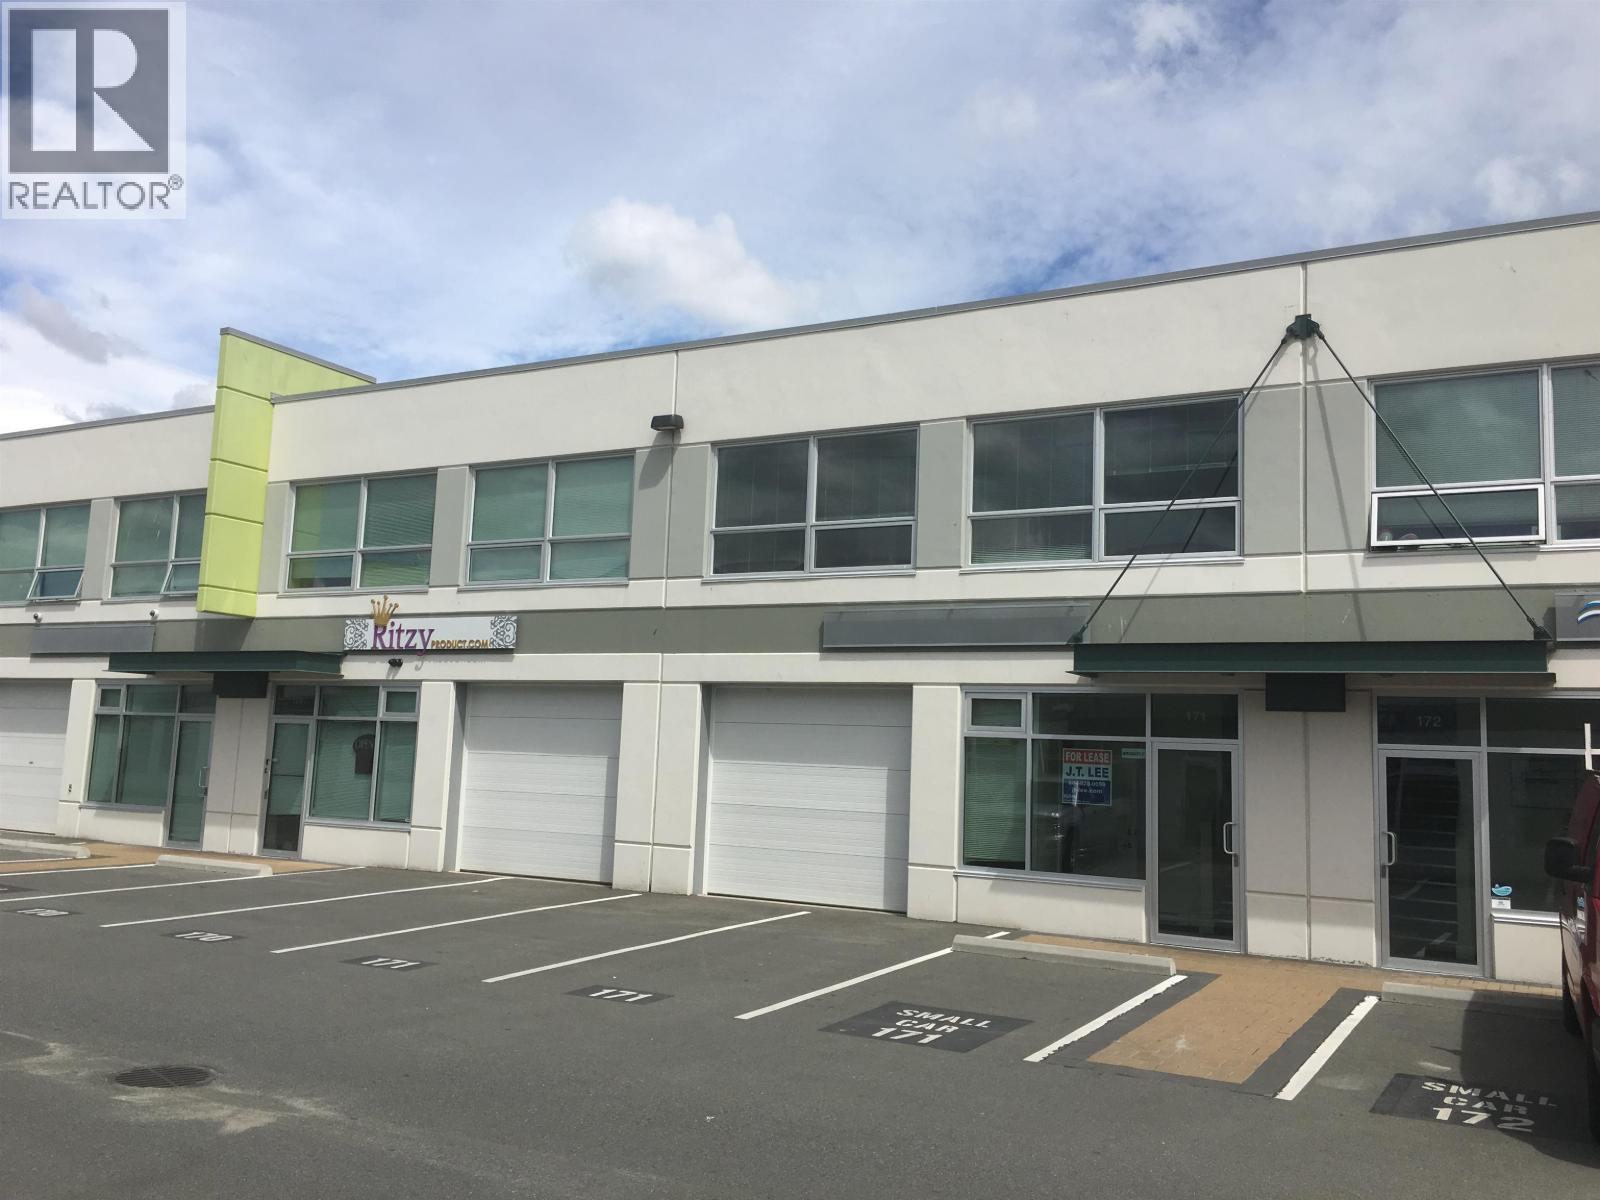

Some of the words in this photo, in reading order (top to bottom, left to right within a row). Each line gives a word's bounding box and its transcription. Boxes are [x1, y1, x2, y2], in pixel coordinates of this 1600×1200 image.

[371, 621, 435, 657] Ritzy
[431, 639, 490, 650] PRODUCT.COM
[1186, 711, 1207, 721] 171
[1418, 715, 1442, 728] 172
[1065, 751, 1082, 762] FOR
[1083, 752, 1110, 764] LEASE
[1066, 766, 1085, 777] J.T.
[1087, 767, 1109, 778] LEE
[360, 957, 421, 969] 171
[588, 988, 653, 1002] 171
[895, 1018, 959, 1033] CAR
[896, 1009, 992, 1028] SMALL
[871, 1027, 943, 1044] 171
[1421, 1081, 1558, 1108] SMALL
[1443, 1096, 1529, 1116] CAR
[1432, 1106, 1536, 1133] 172
